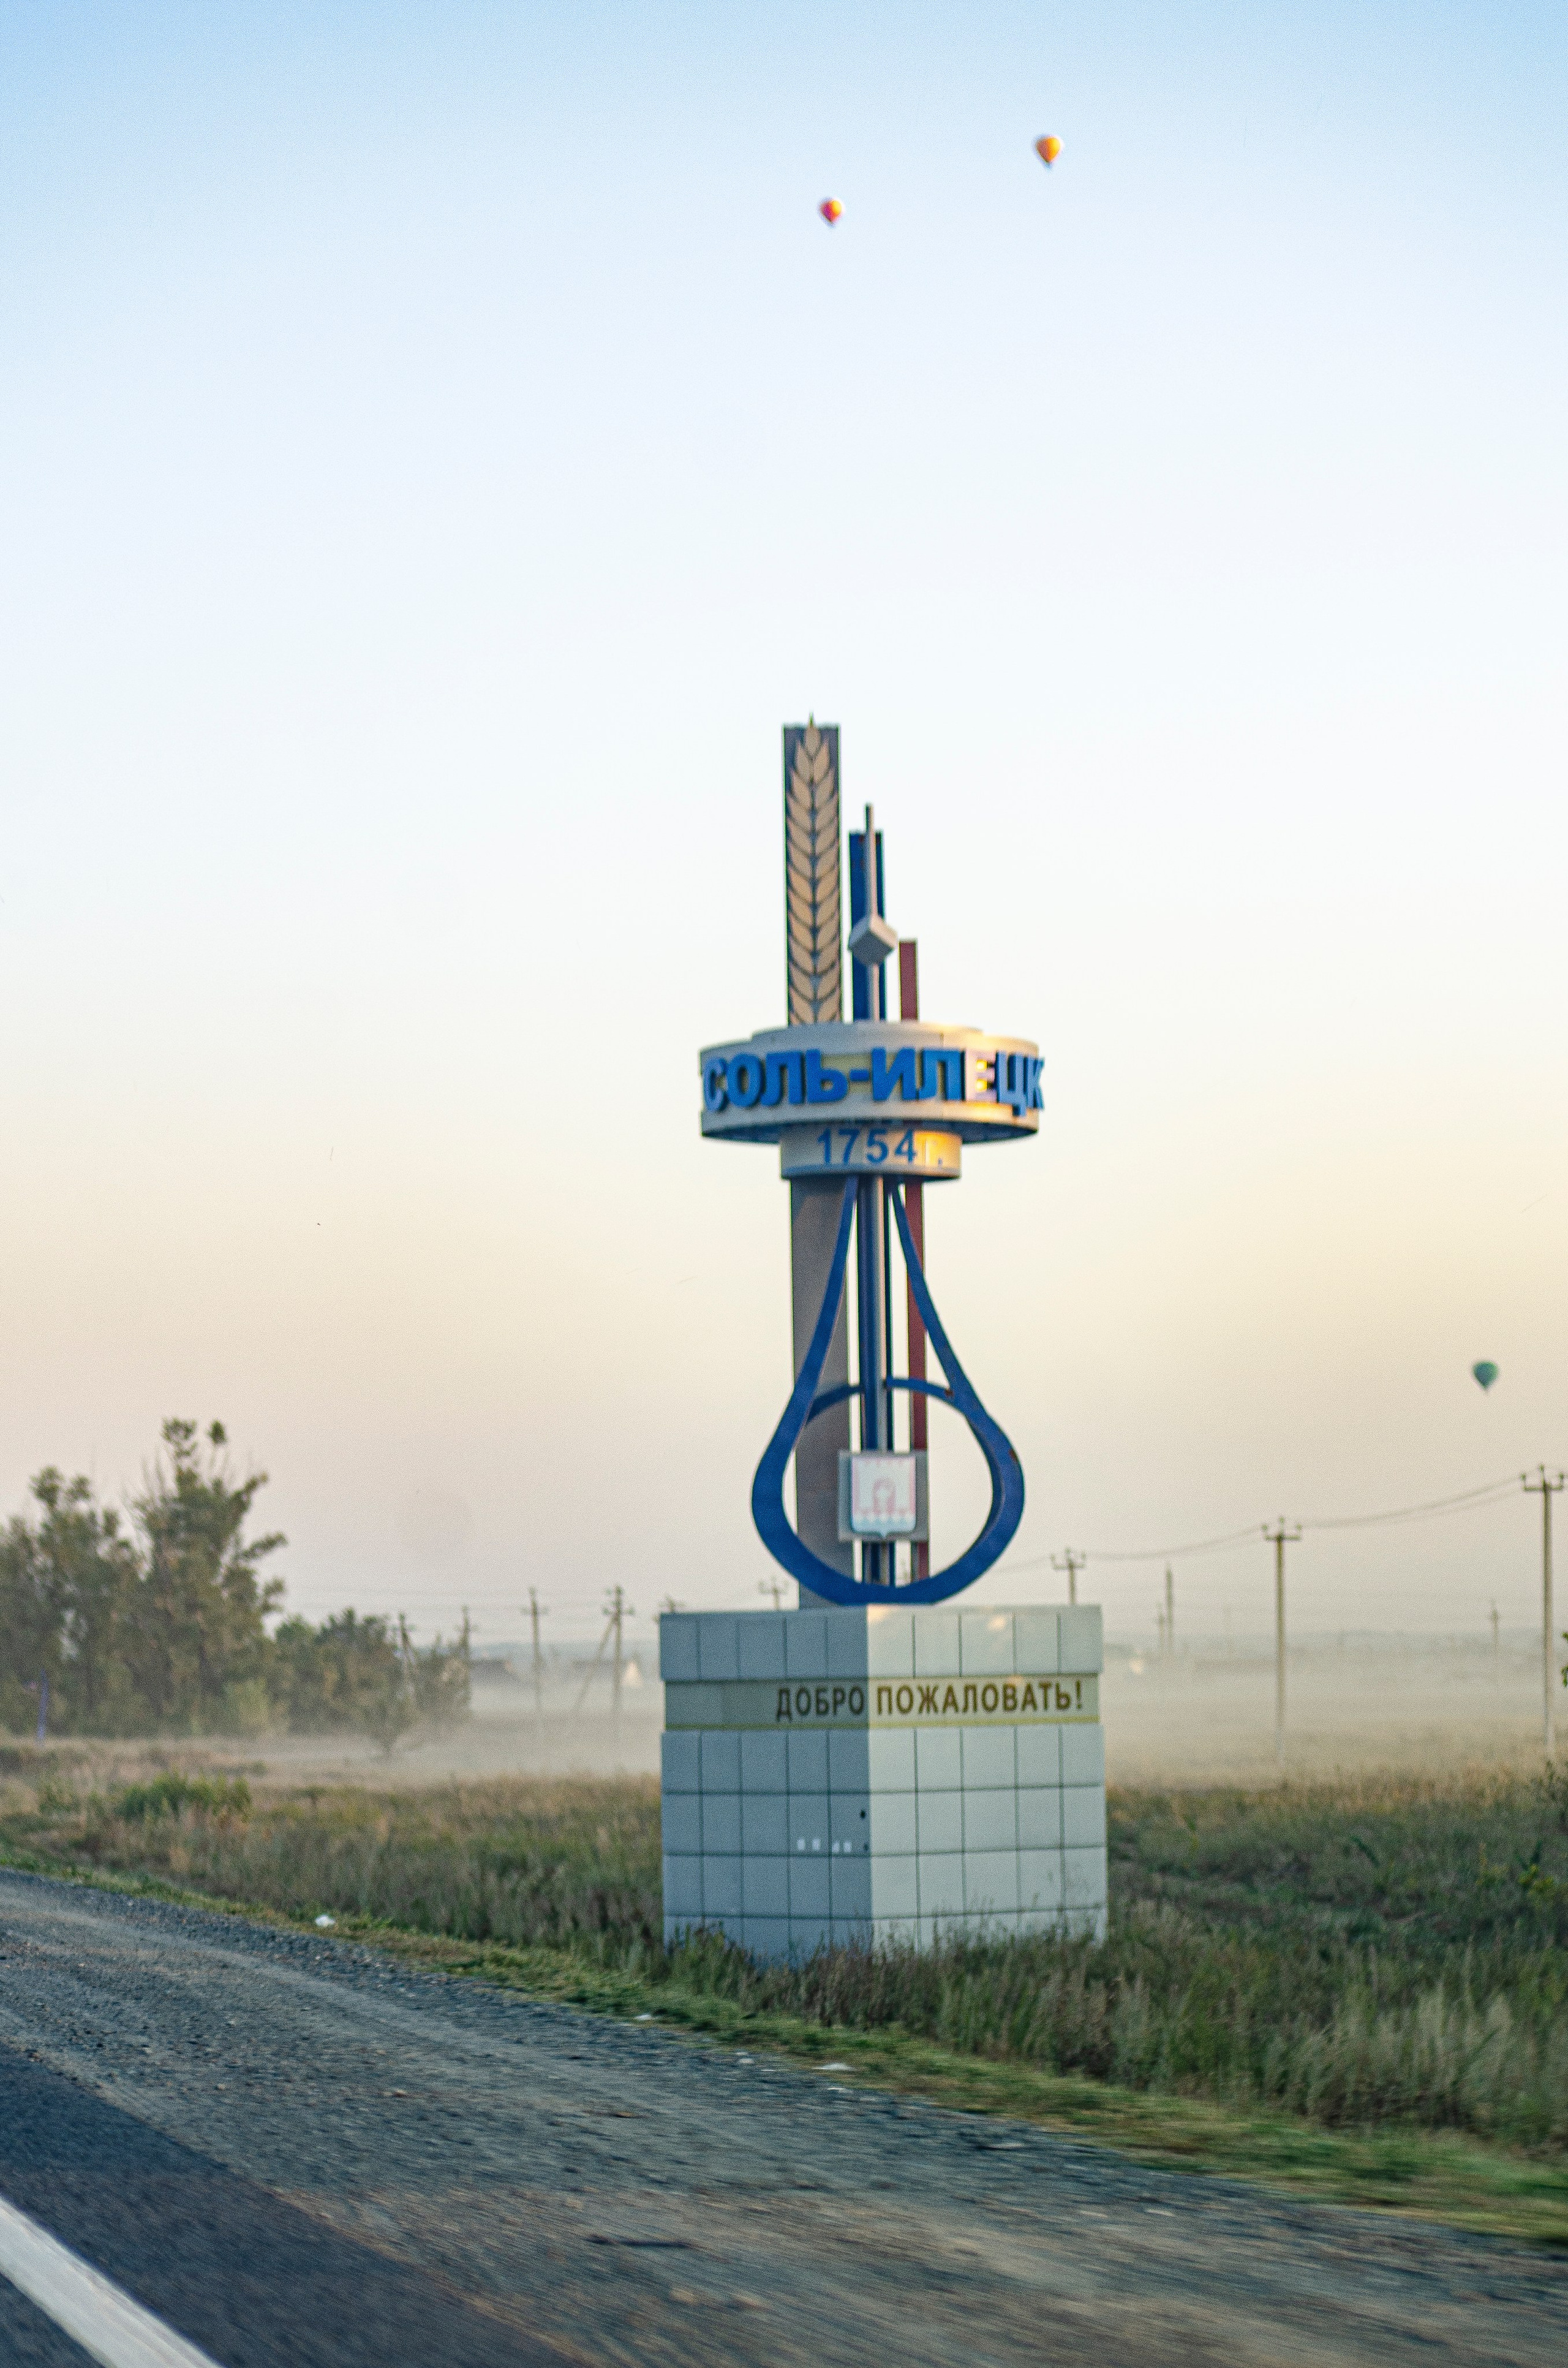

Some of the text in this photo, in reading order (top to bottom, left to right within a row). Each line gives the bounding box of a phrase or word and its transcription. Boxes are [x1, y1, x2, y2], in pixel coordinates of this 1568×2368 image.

[703, 1046, 1044, 1116] СОЛЬ-ИЛЕЦК
[775, 1681, 1084, 1722] ДОБРО ПОЖАЛОВАТЬ!
